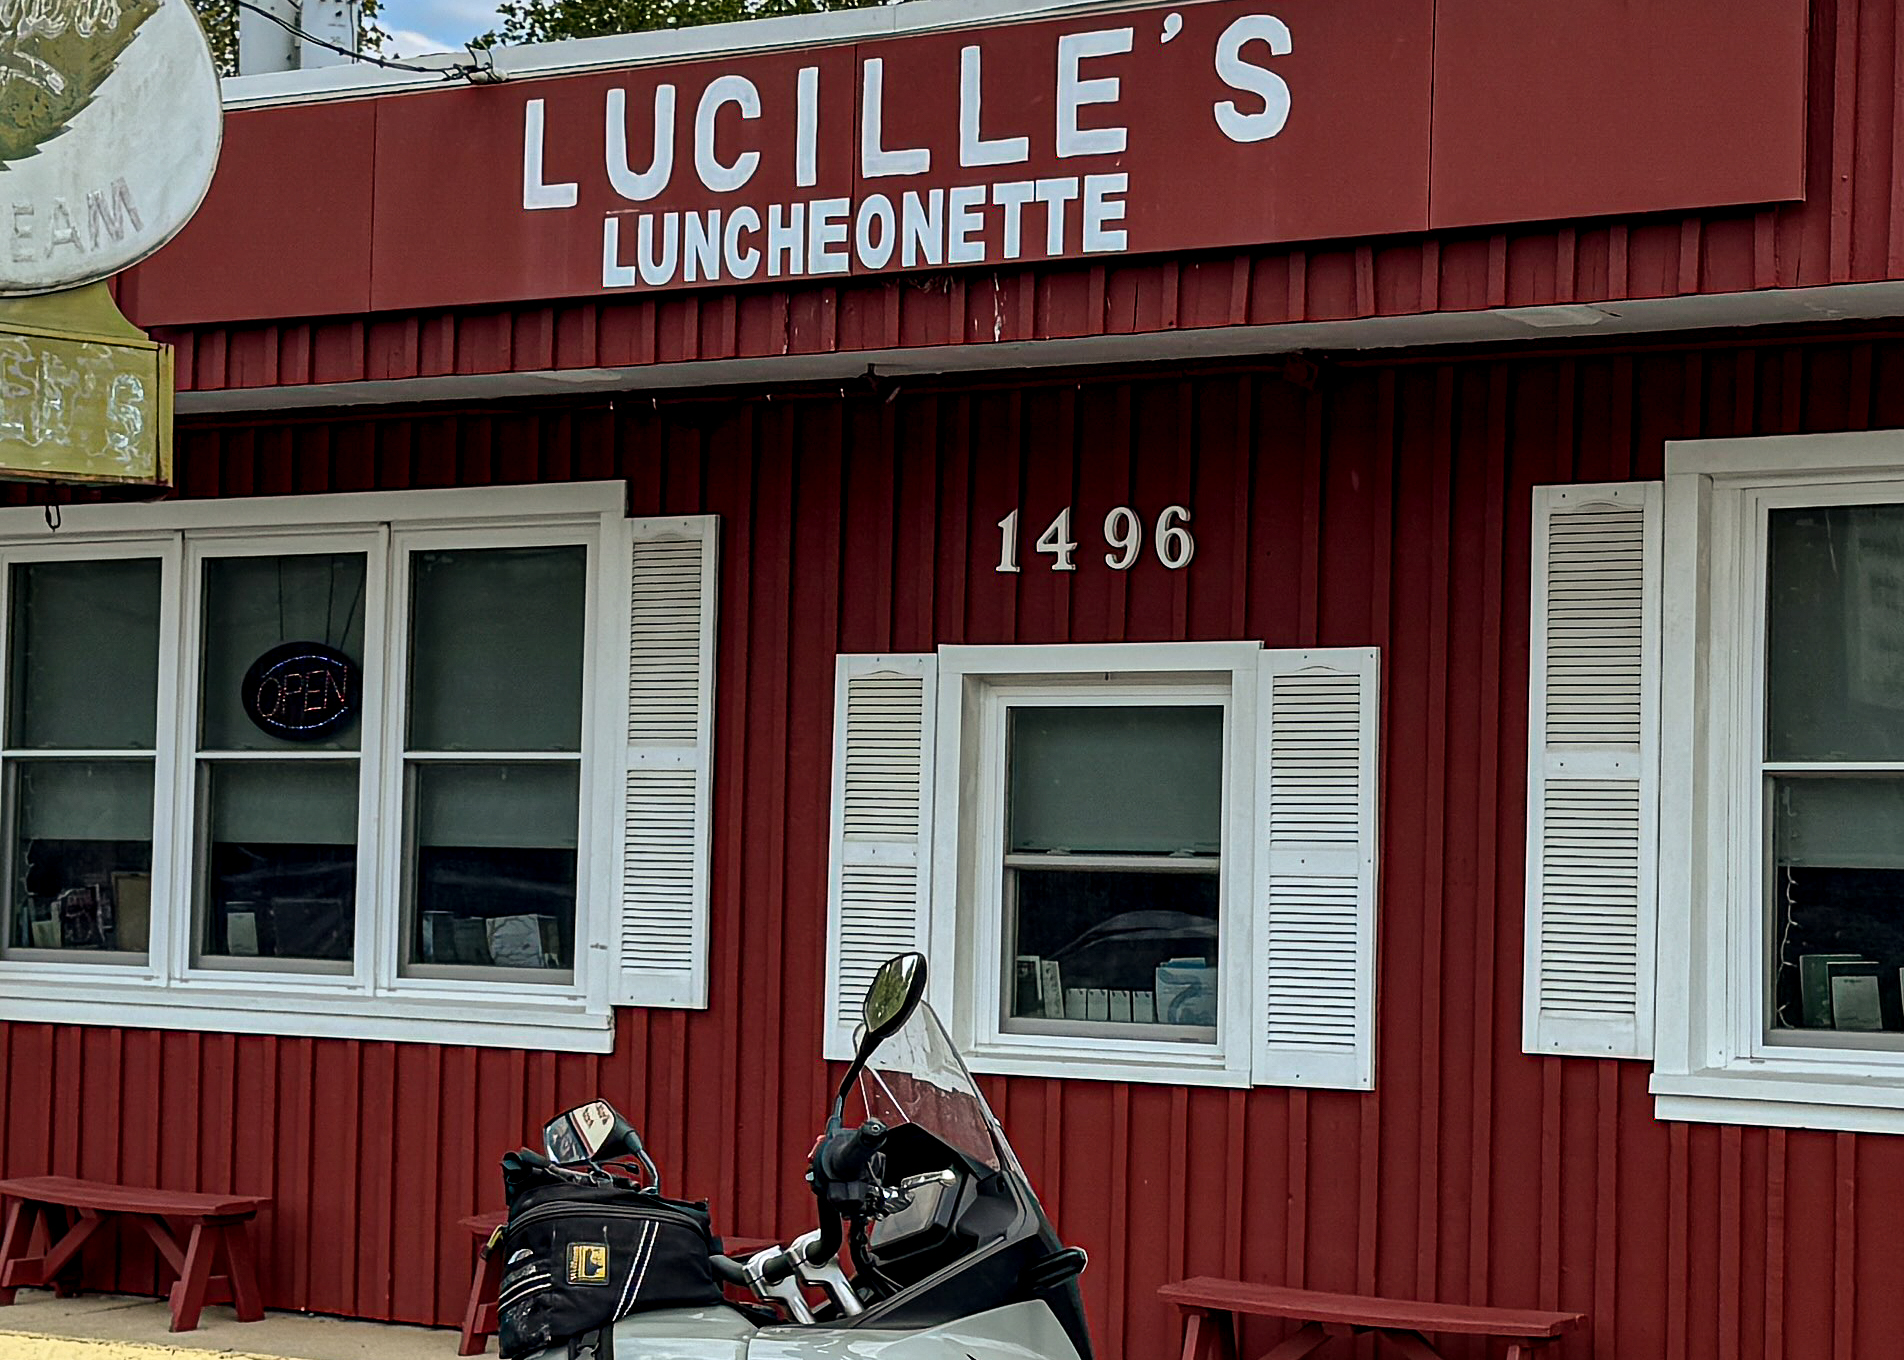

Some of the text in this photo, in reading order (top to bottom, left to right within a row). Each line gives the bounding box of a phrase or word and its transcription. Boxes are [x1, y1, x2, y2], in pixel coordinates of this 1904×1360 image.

[523, 12, 1292, 210] LUCILLE'S
[602, 172, 1130, 288] LUNCHEONETTE
[996, 505, 1195, 573] 1496
[256, 666, 348, 717] OPEN
